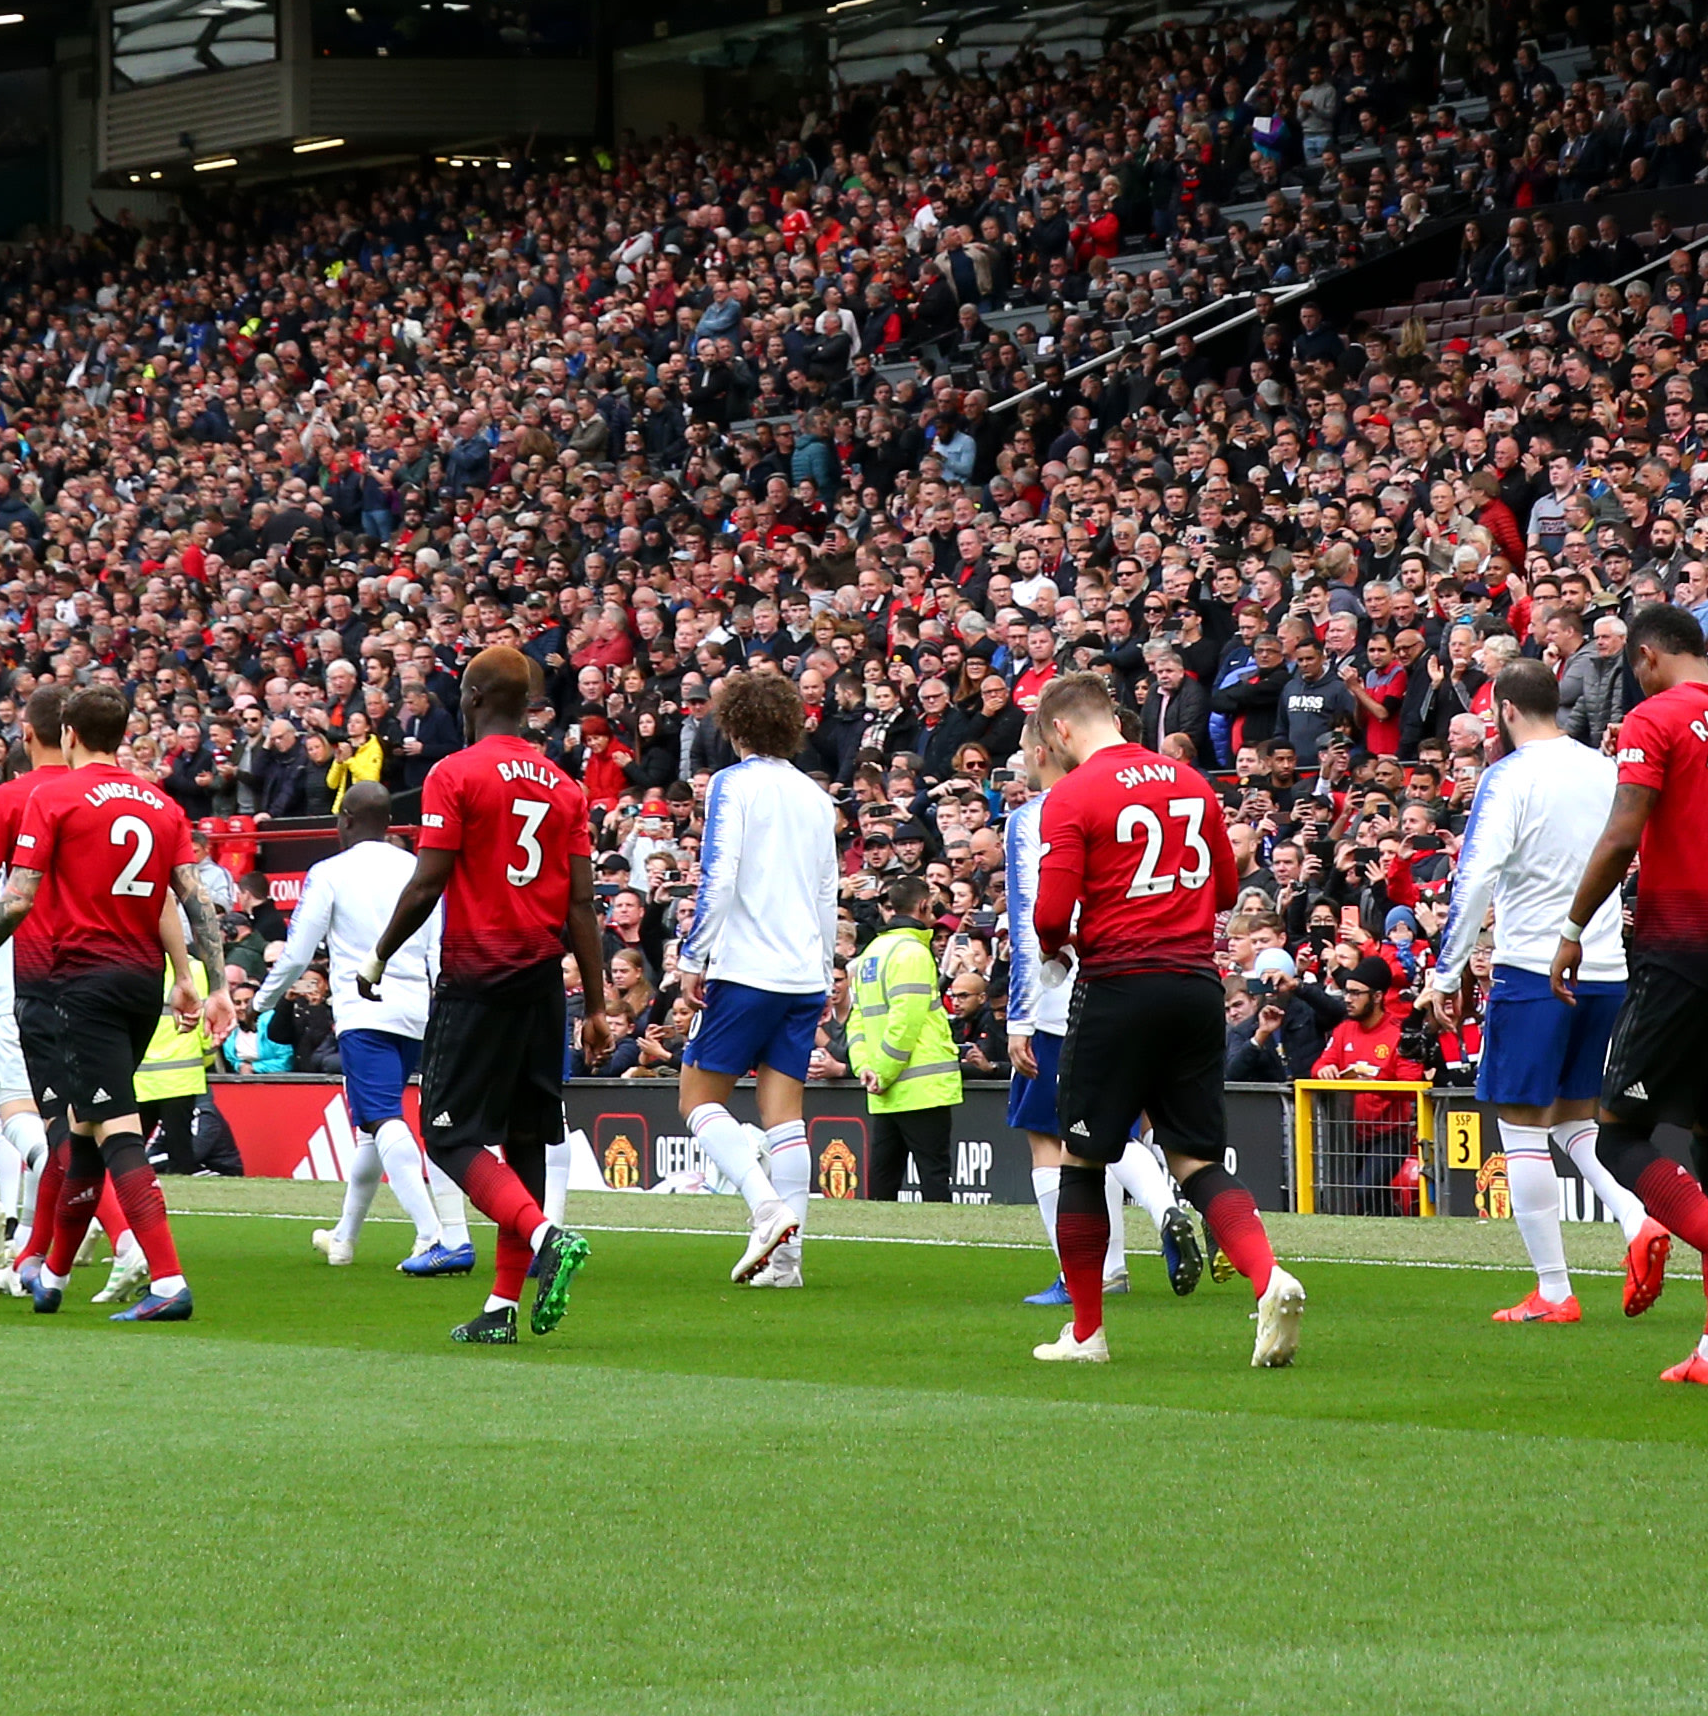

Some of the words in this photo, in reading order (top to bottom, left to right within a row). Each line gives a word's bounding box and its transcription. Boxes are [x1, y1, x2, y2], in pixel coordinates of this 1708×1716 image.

[1287, 695, 1324, 709] BOSS
[497, 760, 561, 790] BAILLY
[1115, 764, 1176, 790] SHAW
[84, 782, 165, 811] LINDELOF
[110, 814, 155, 898] 2
[506, 798, 551, 887] 3
[1116, 797, 1212, 899] 23
[1455, 1115, 1472, 1127] SSP
[656, 1135, 714, 1178] OFFICI
[956, 1141, 993, 1186] APP
[1458, 1128, 1470, 1164] 3
